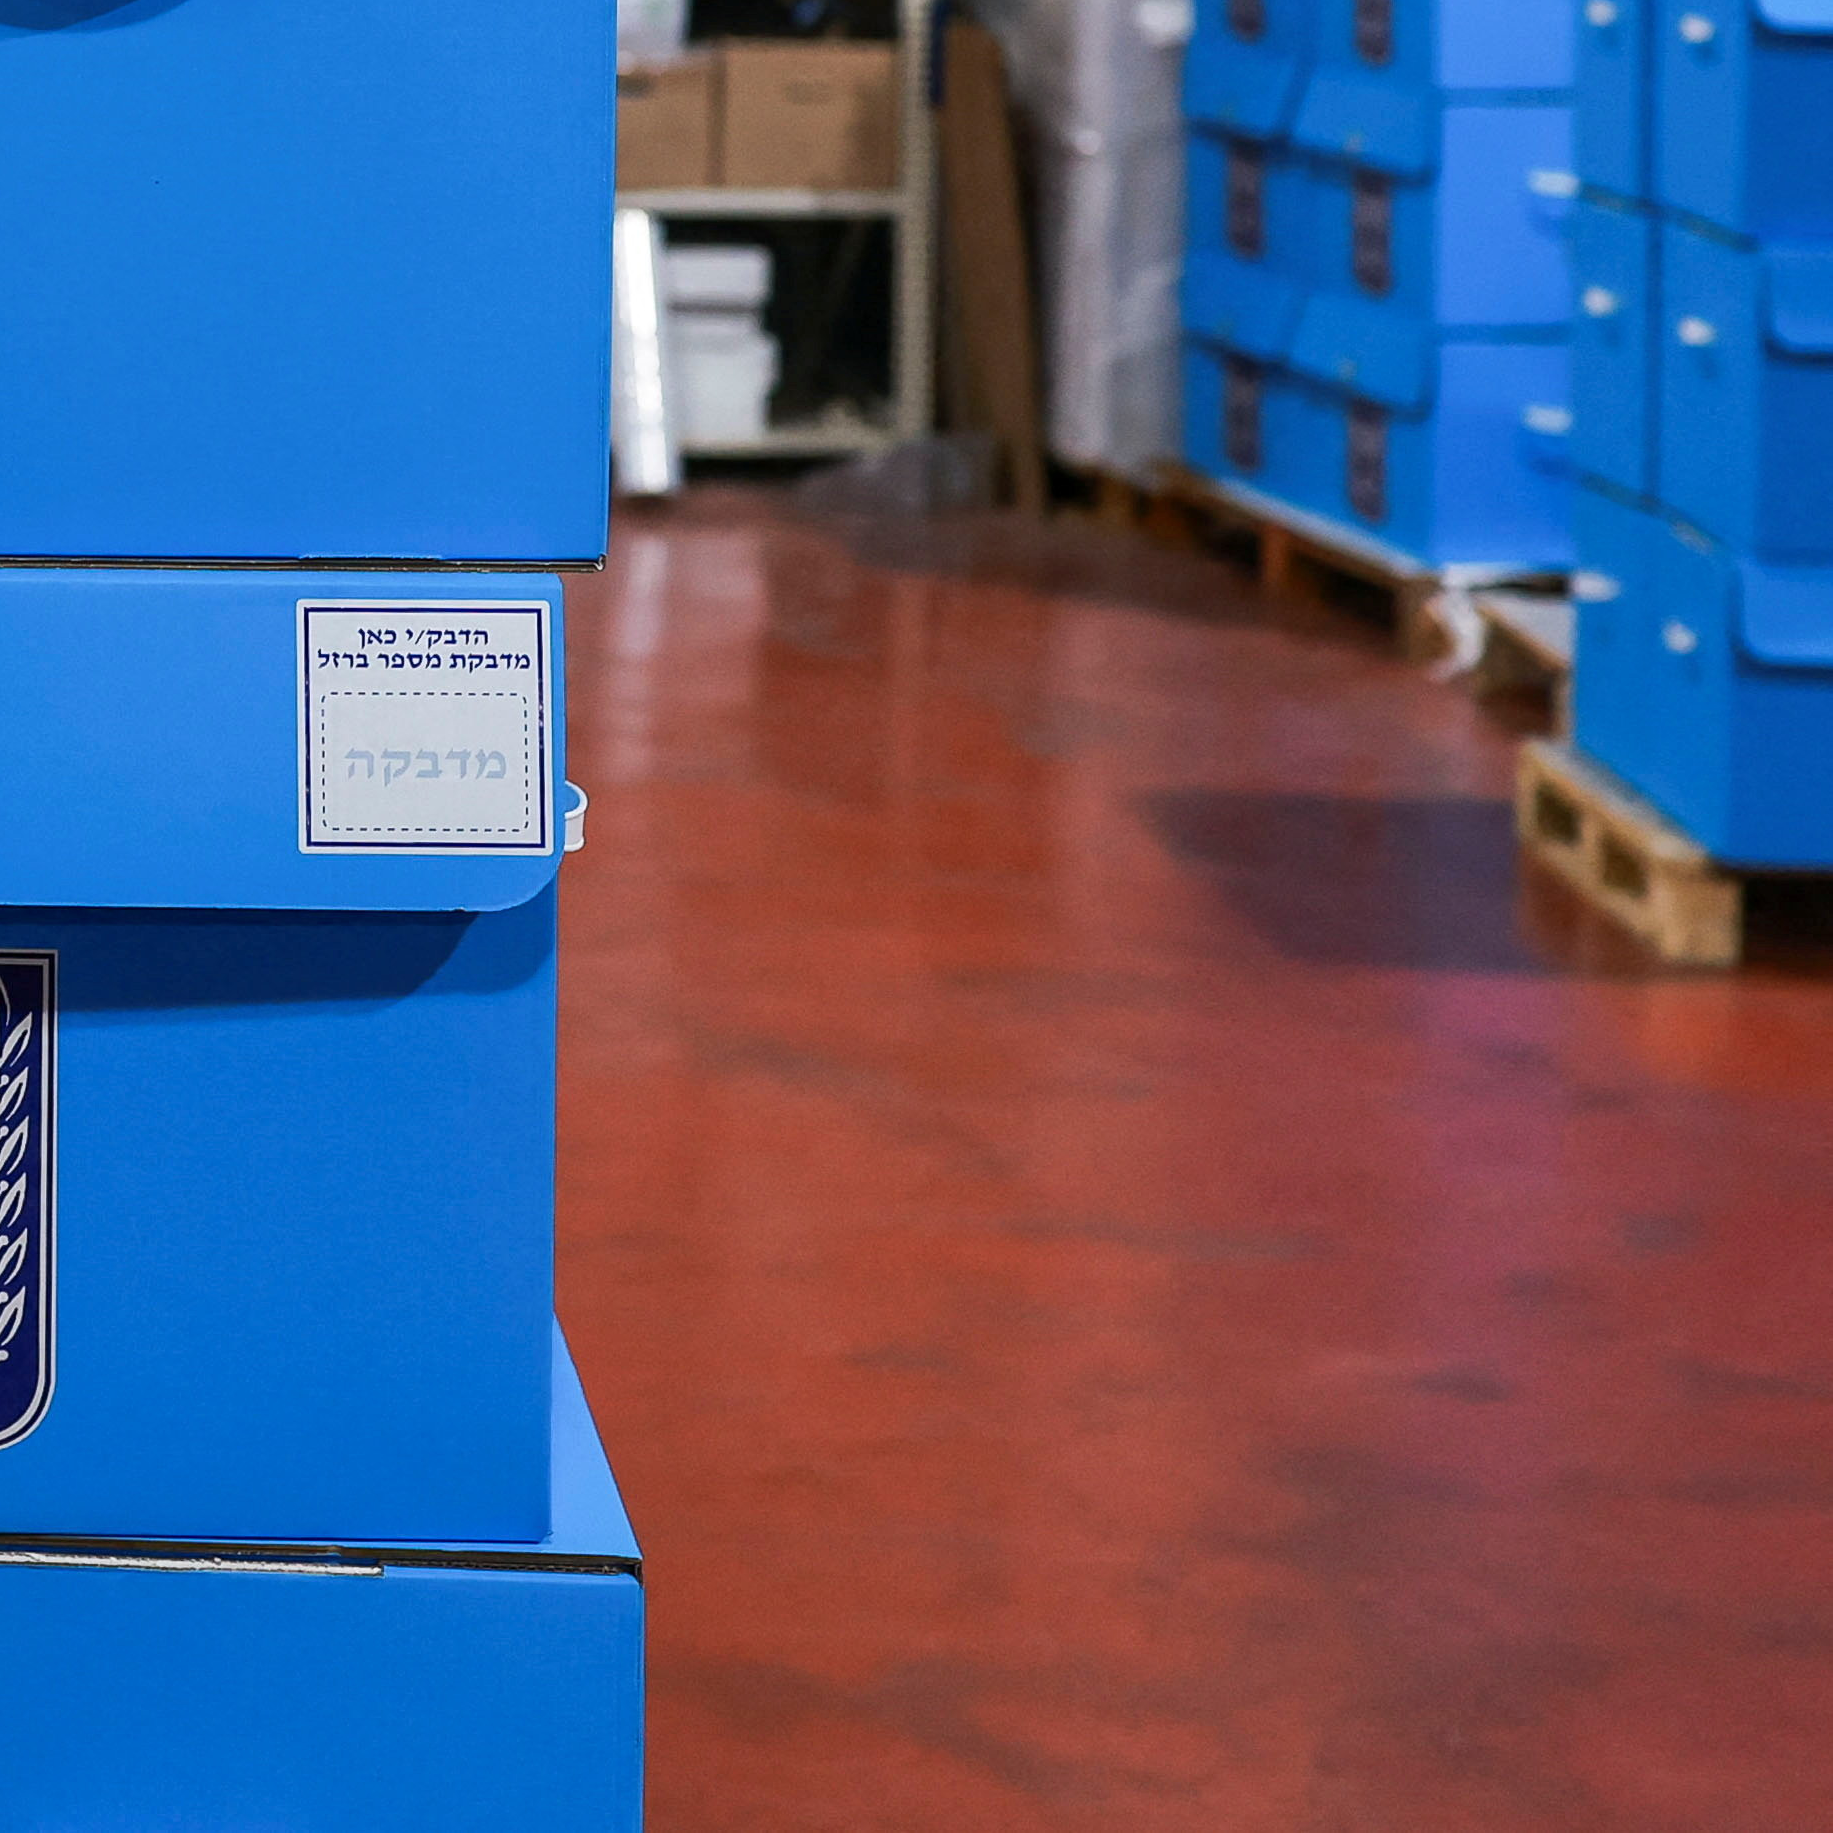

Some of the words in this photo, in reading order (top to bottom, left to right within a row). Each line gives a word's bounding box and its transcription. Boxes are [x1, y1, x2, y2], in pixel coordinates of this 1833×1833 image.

[358, 628, 398, 650] כאן
[406, 629, 489, 649] הדבק/י
[317, 650, 370, 668] ברזל
[377, 653, 442, 669] מספר
[449, 653, 531, 673] מדבקת
[343, 748, 507, 788] מדבקה
